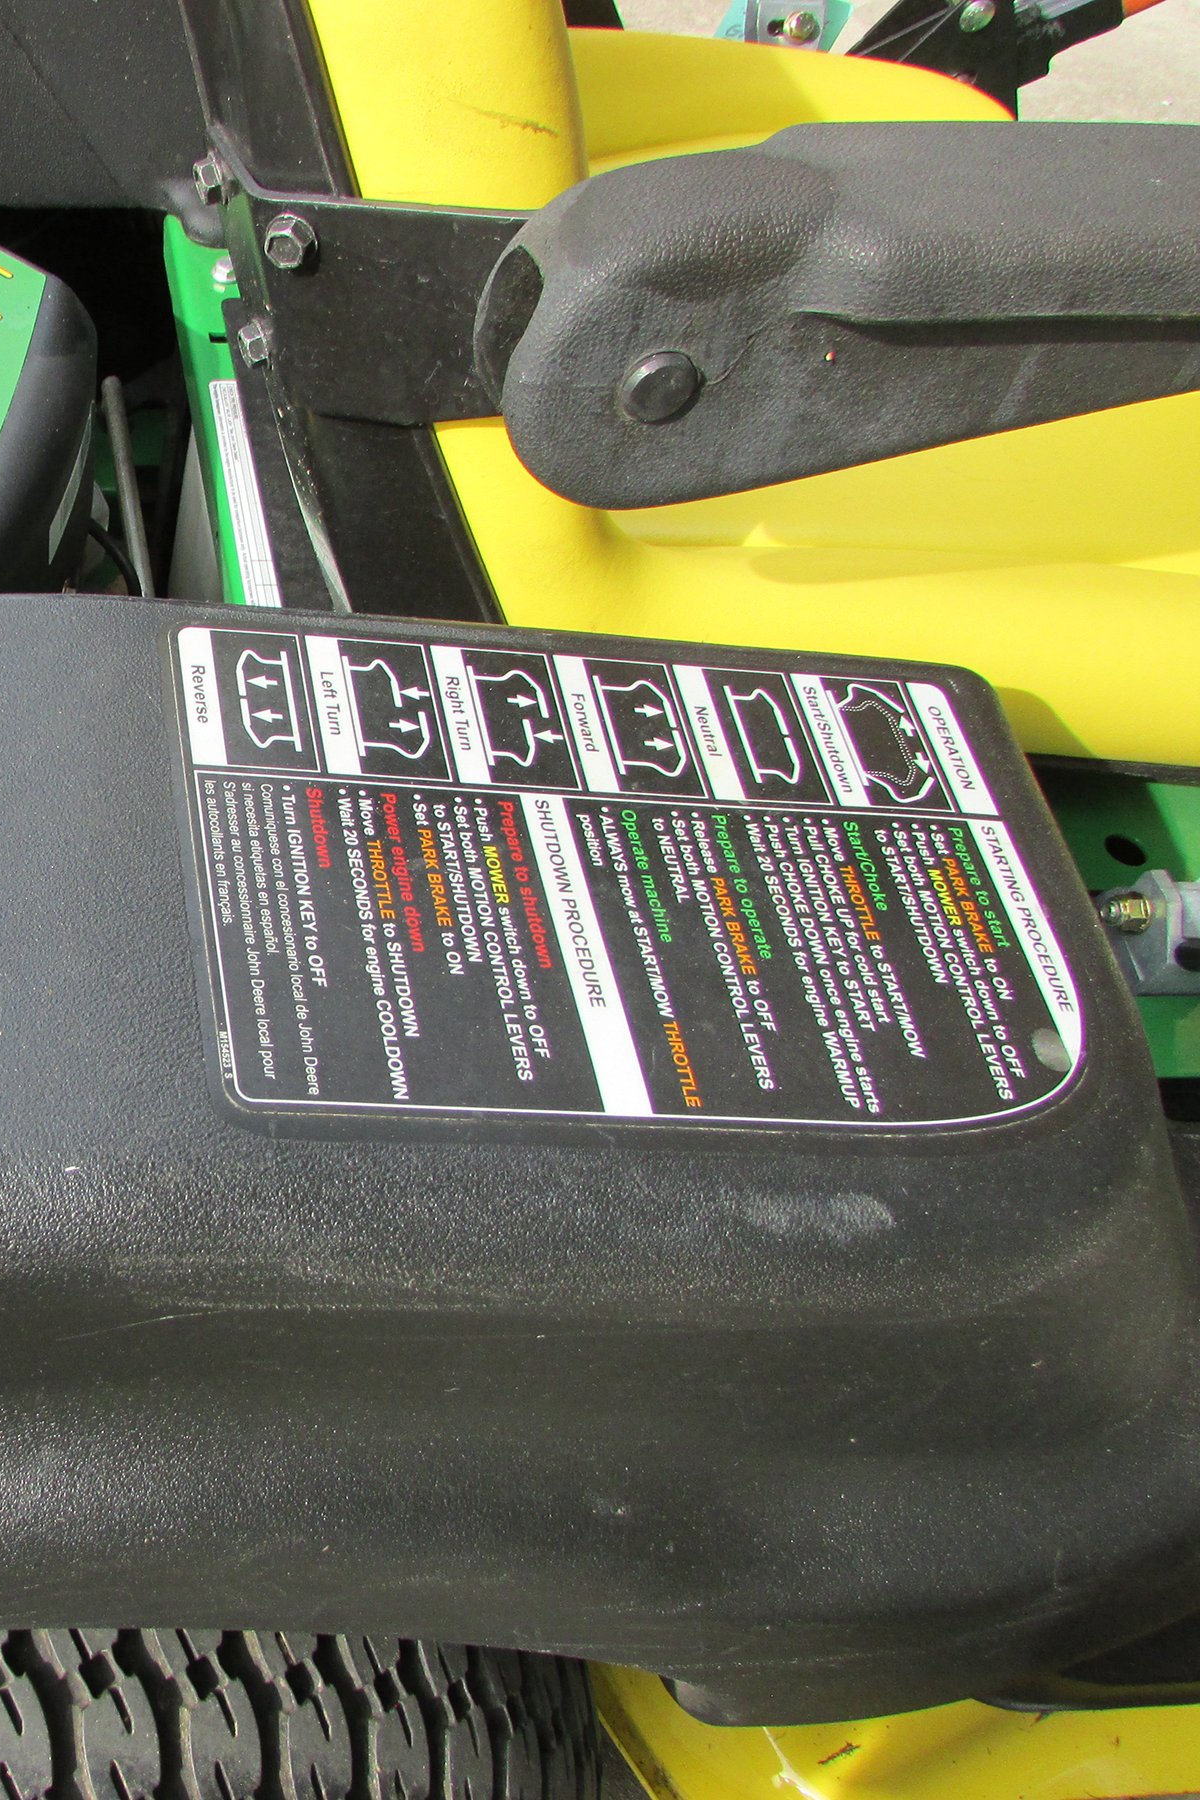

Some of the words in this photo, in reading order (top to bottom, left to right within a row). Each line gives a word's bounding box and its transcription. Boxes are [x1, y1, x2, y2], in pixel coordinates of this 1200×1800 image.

[191, 665, 209, 724] Reverse
[320, 671, 338, 699] Left
[326, 703, 341, 736] Turn
[445, 676, 465, 714] Right
[455, 719, 472, 751] Turn
[571, 693, 600, 752] Forward
[694, 706, 723, 757] Neutral
[802, 686, 853, 793] Start/Shutdown
[928, 706, 976, 790] OPERATION
[204, 779, 217, 795] les
[241, 782, 252, 791] si
[206, 797, 226, 861] autocollants
[222, 781, 240, 837] S'adresser
[243, 793, 260, 837] necesita
[281, 794, 296, 825] Turn
[305, 787, 331, 868] Shutdown
[337, 797, 355, 827] Wait
[358, 798, 375, 836] Move
[412, 802, 430, 826] Set
[432, 804, 446, 818] to
[453, 805, 470, 829] Set
[473, 807, 494, 842] Push
[651, 818, 665, 832] to
[671, 819, 690, 841] Set
[230, 838, 242, 853] au
[343, 829, 359, 846] 20
[417, 829, 440, 870] PARK
[459, 831, 479, 863] both
[498, 801, 523, 862] Prepare
[575, 814, 604, 866] position
[599, 814, 628, 872] ALWAYS
[690, 820, 718, 874] Release
[711, 815, 741, 874] Prepare
[745, 823, 767, 853] Wait
[784, 825, 804, 855] Turn
[803, 826, 825, 851] Pull
[215, 863, 227, 877] en
[249, 839, 267, 889] etiquetas
[271, 857, 284, 878] con
[286, 829, 312, 896] IGNITION
[366, 839, 396, 919] THROTTLE
[380, 793, 401, 843] Power
[391, 846, 414, 902] engine
[403, 906, 425, 952] down
[482, 845, 510, 904] MOWER
[514, 866, 529, 882] to
[621, 809, 649, 870] Operate
[641, 875, 672, 943] machine
[657, 835, 690, 904] NEUTRAL
[679, 844, 701, 875] both
[756, 855, 775, 872] 20
[814, 854, 846, 905] CHOKE
[843, 821, 888, 911] Start/Choke
[217, 880, 233, 928] français.
[233, 855, 256, 945] concessionnaire
[257, 891, 269, 906] en
[275, 880, 289, 891] el
[346, 848, 374, 920] SECONDS
[427, 873, 453, 927] BRAKE
[436, 821, 483, 963] START/SHUTDOWN
[467, 867, 496, 927] MOTION
[534, 799, 573, 893] SHUTDOWN
[561, 898, 606, 1007] PROCEDURE
[617, 875, 637, 908] mow
[710, 877, 737, 917] PARK
[733, 878, 748, 894] to
[796, 858, 834, 922] IGNITION
[947, 827, 981, 886] Prepare
[975, 890, 990, 906] to
[984, 910, 1011, 947] start
[298, 899, 318, 932] KEY
[519, 887, 552, 969] shutdown
[628, 910, 644, 924] at
[691, 879, 724, 938] MOTION
[740, 898, 772, 959] operate
[764, 875, 803, 947] SECONDS
[835, 908, 855, 929] UP
[874, 829, 888, 843] to
[881, 846, 949, 984] START/SHUTDOWN
[930, 832, 951, 855] Set
[942, 858, 969, 897] PARK
[960, 900, 994, 953] BRAKE
[983, 958, 998, 973] to
[992, 976, 1013, 1000] ON
[981, 826, 1025, 902] STARTING
[1016, 907, 1074, 1011] PROCEDURE
[259, 908, 280, 957] español.
[277, 893, 299, 971] concesionario
[304, 935, 319, 951] to
[360, 923, 377, 945] for
[382, 922, 397, 938] to
[441, 932, 455, 947] to
[498, 907, 522, 955] switch
[725, 921, 757, 975] BRAKE
[822, 926, 848, 958] KEY
[822, 827, 845, 862] Move
[839, 865, 880, 940] THROTTLE
[869, 944, 884, 959] to
[877, 962, 926, 1058] START/MOW
[844, 931, 862, 952] for
[246, 947, 262, 976] John
[308, 954, 328, 988] OFF
[365, 946, 386, 996] engine
[445, 951, 465, 975] ON
[483, 931, 515, 1009] CONTROL
[633, 926, 675, 1018] START/MOW
[764, 824, 788, 858] Push
[779, 861, 810, 914] CHOKE
[799, 917, 830, 965] DOWN
[819, 968, 842, 1005] once
[834, 1009, 863, 1062] engine
[855, 1066, 880, 1113] starts
[792, 951, 810, 973] for
[836, 960, 851, 976] to
[854, 954, 878, 986] cold
[893, 830, 913, 853] Set
[903, 855, 926, 886] both
[917, 890, 954, 949] MOTION
[944, 952, 985, 1030] CONTROL
[976, 1033, 1014, 1100] LEVERS
[911, 831, 936, 865] Push
[927, 869, 963, 926] MOWER
[952, 928, 982, 976] switch
[974, 980, 999, 1021] down
[992, 1024, 1007, 1040] to
[1001, 1044, 1026, 1078] OFF
[250, 979, 266, 1016] Deere
[290, 974, 308, 1002] local
[386, 941, 420, 1037] SHUTDOWN
[511, 958, 532, 1000] down
[713, 941, 750, 1019] CONTROL
[746, 980, 761, 995] to
[801, 975, 829, 1027] engine
[295, 1004, 310, 1020] de
[523, 1004, 537, 1021] to
[753, 999, 777, 1032] OFF
[843, 979, 876, 1032] START
[867, 989, 892, 1023] start
[218, 1031, 233, 1070] M154523
[256, 1018, 274, 1047] local
[298, 1022, 314, 1053] John
[376, 999, 410, 1100] COOLDOWN
[503, 1013, 534, 1081] LEVERS
[528, 1024, 551, 1059] OFF
[258, 1050, 276, 1080] pour
[303, 1056, 320, 1096] Deere
[663, 1020, 702, 1107] THROTTLE
[739, 1023, 775, 1090] LEVERS
[822, 1031, 861, 1108] WARMUP
